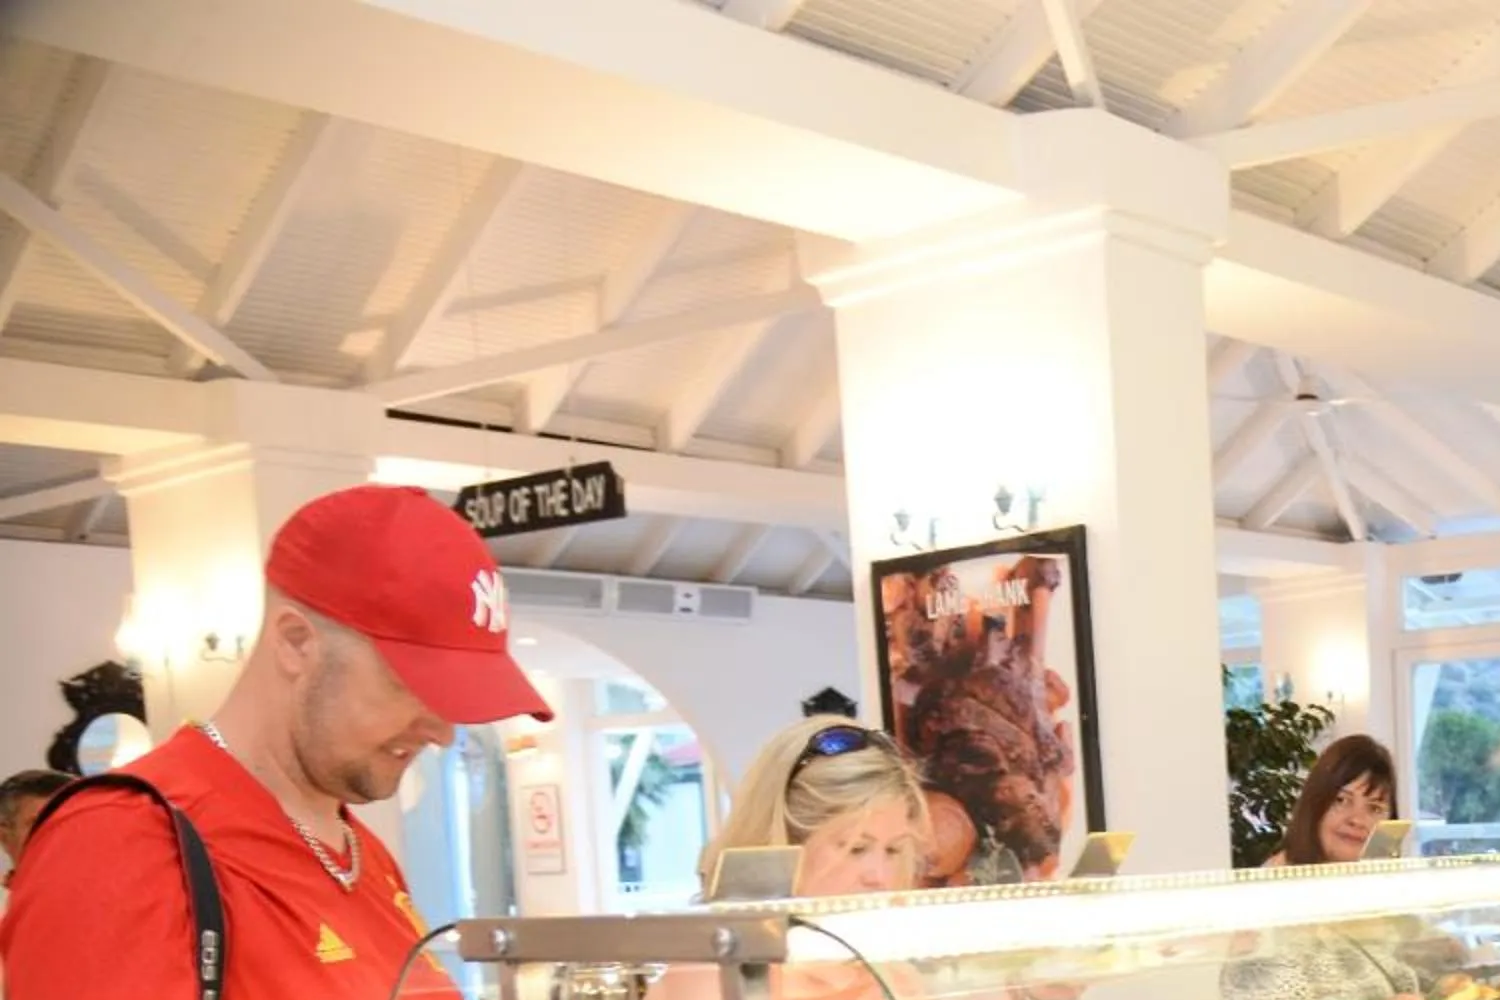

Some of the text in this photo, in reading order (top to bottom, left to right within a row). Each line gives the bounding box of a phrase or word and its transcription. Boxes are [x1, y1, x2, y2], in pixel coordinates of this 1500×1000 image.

[464, 473, 606, 528] SOUP OF THE DAY
